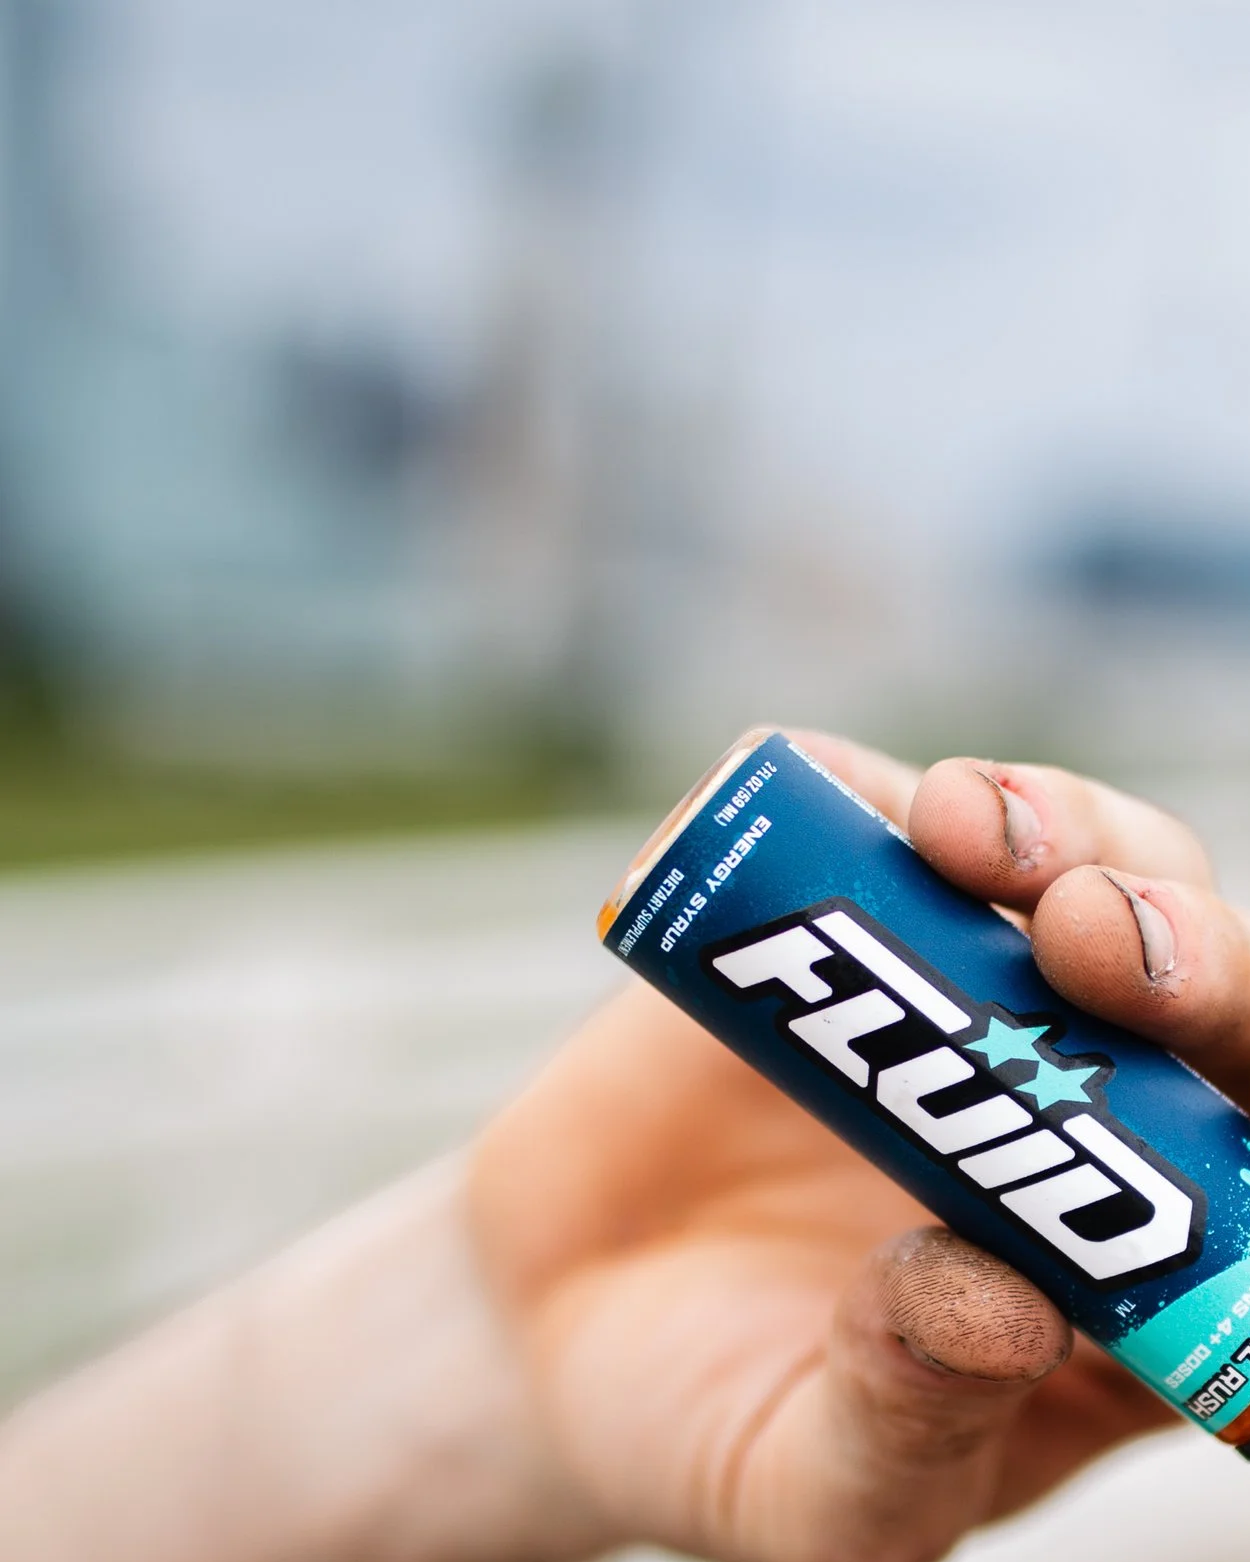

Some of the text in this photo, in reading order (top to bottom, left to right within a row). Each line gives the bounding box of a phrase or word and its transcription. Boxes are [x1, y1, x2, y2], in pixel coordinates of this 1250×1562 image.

[713, 761, 777, 827] 2 FL OZ (59 ML)
[618, 868, 685, 956] DIETARY SUPPLEMENT
[661, 815, 772, 952] ENERGY SYRUP
[712, 910, 1193, 1280] FLUID
[1114, 1299, 1137, 1318] TM
[1210, 1317, 1233, 1345] 4+
[1164, 1343, 1212, 1389] DOSES
[1187, 1363, 1248, 1421] RUSH
